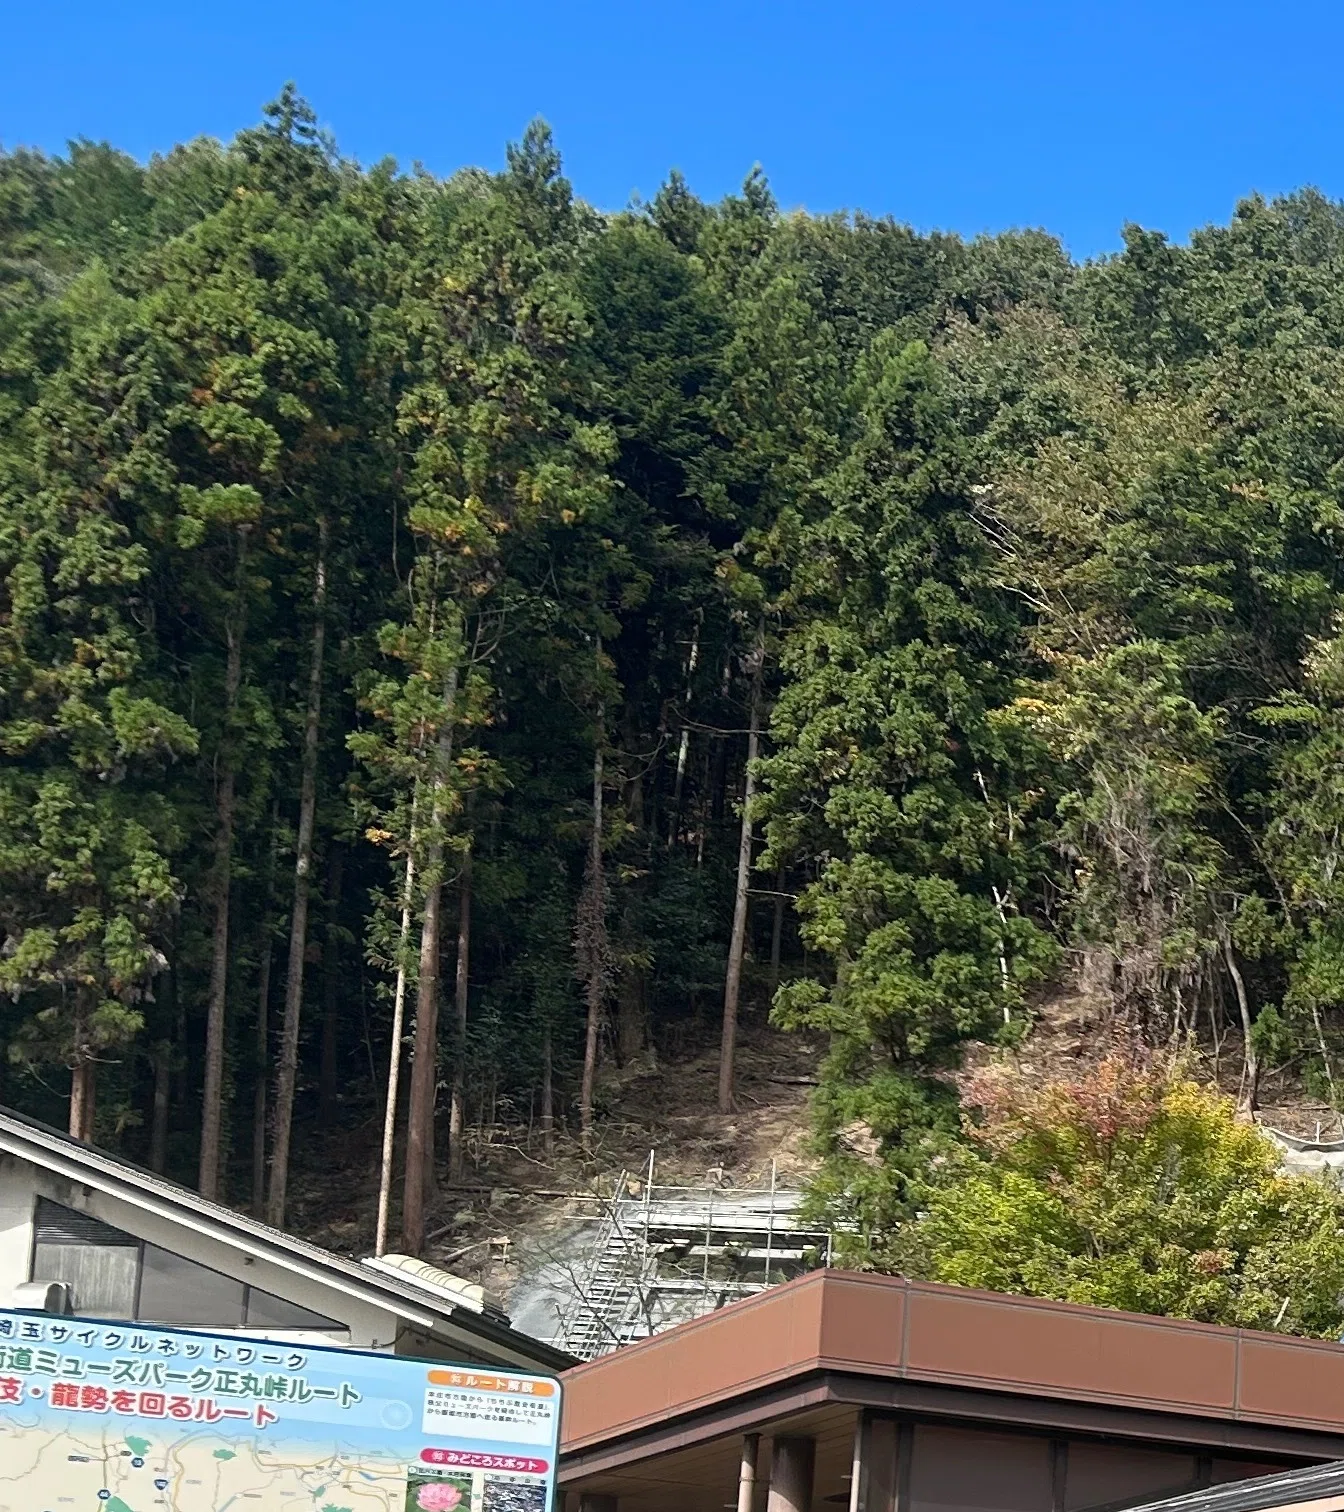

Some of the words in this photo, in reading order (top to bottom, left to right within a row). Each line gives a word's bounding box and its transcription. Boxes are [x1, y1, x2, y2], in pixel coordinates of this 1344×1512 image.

[447, 1452, 538, 1471] みどころスポット
